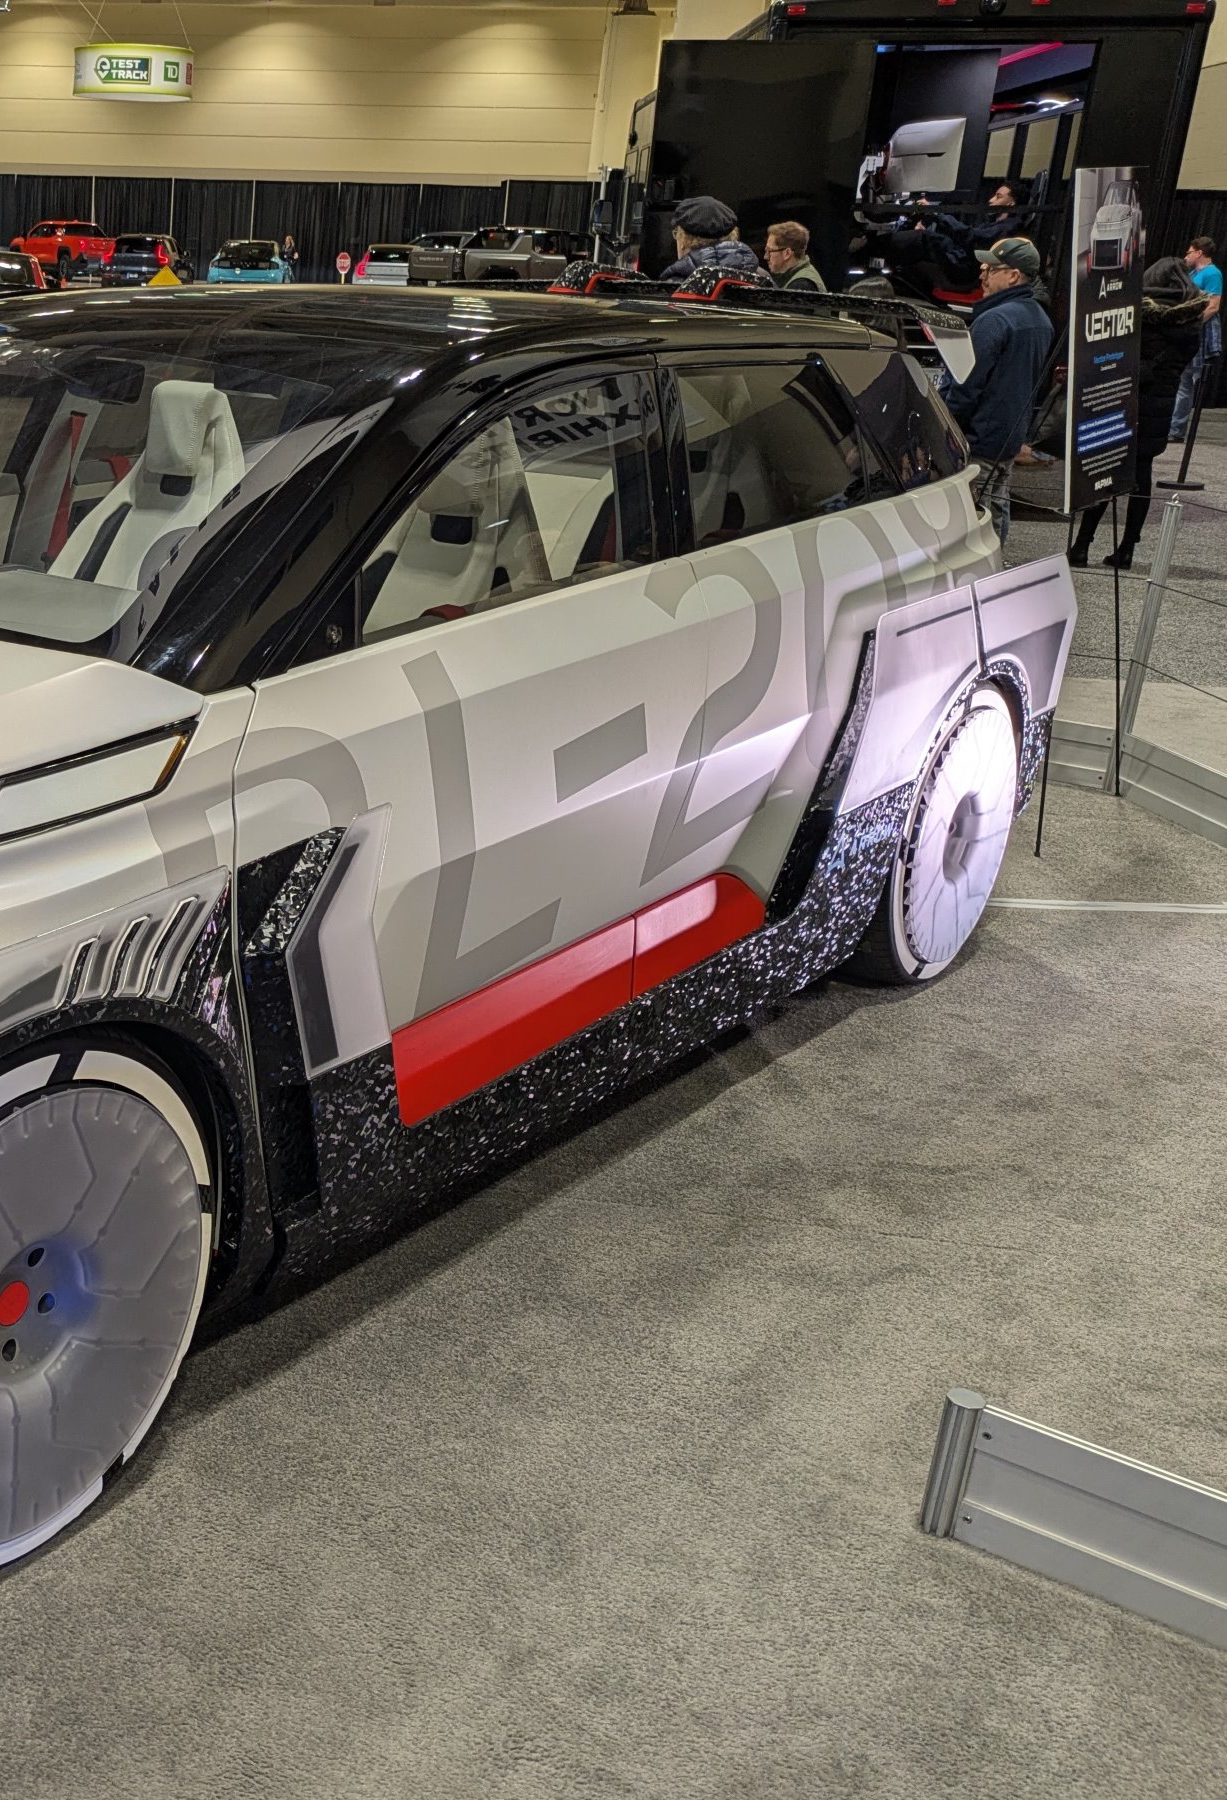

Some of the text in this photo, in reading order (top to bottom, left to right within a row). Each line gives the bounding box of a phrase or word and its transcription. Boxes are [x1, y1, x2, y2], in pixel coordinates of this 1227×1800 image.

[110, 59, 142, 69] TEST
[110, 69, 148, 80] TRACK
[338, 259, 350, 268] STOP
